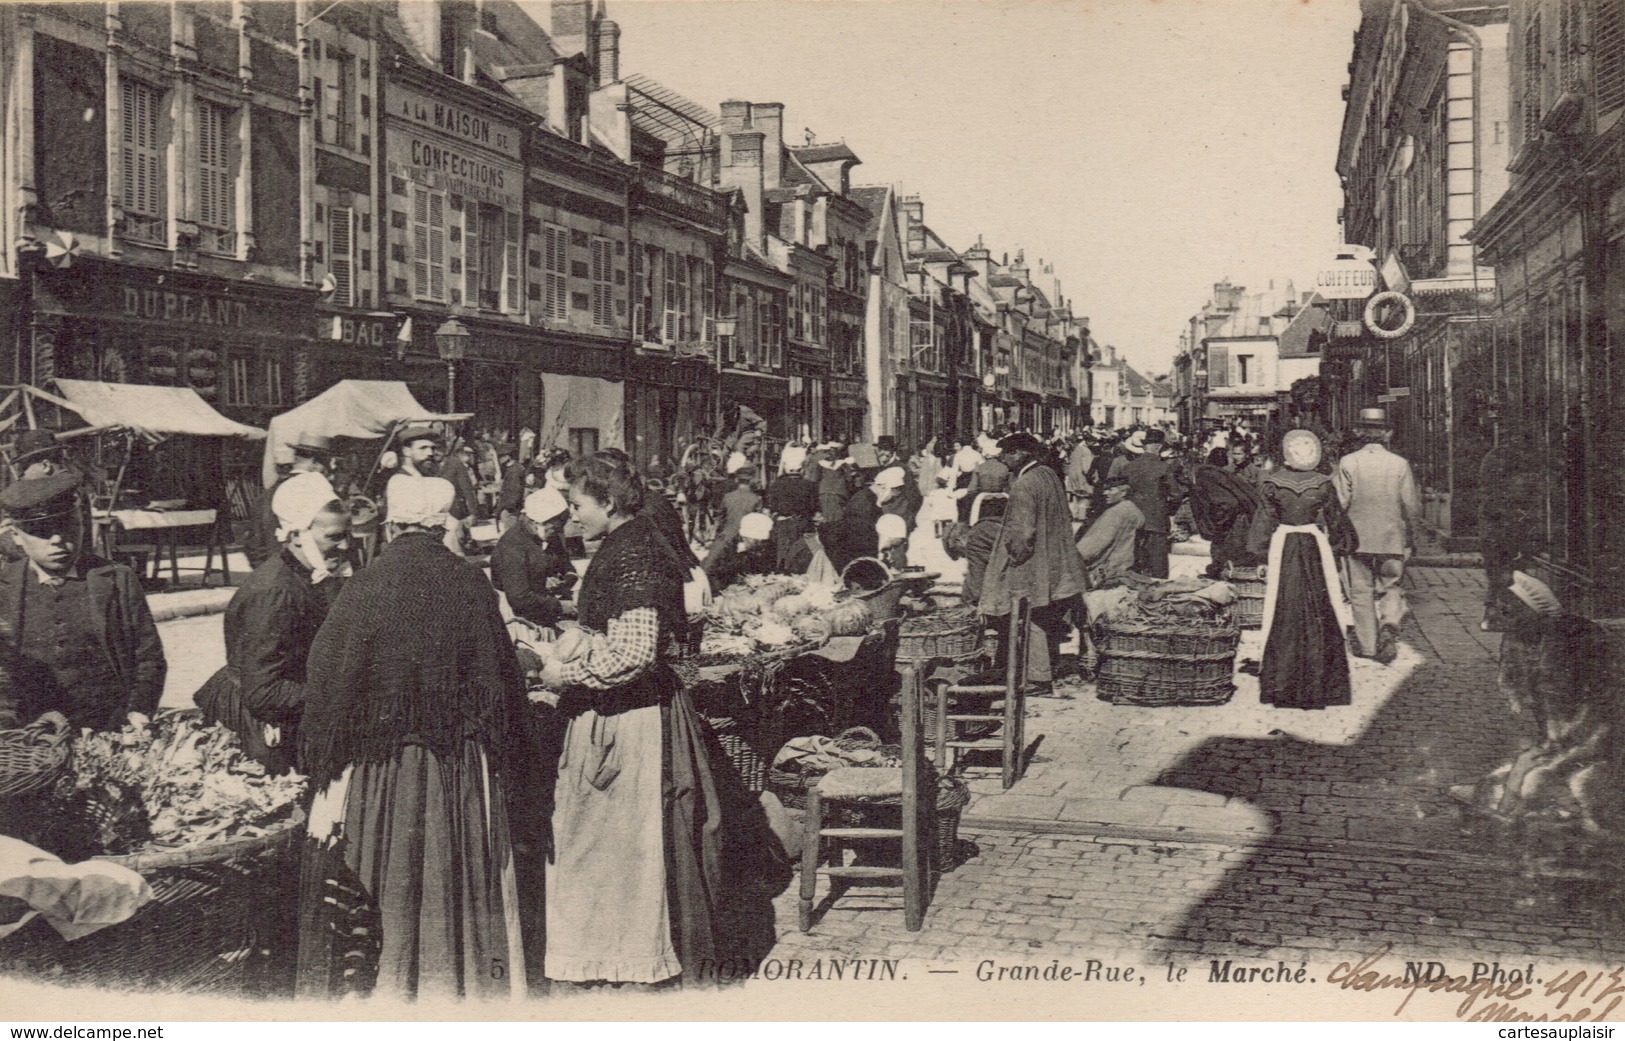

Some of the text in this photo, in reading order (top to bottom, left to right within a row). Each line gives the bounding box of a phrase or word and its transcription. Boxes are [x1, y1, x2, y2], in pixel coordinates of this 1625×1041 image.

[402, 100, 508, 150] A LA MAISON DE
[411, 138, 505, 190] CONFECTIONS
[1317, 269, 1377, 287] COIFFEUR
[124, 287, 248, 327] DUPLANT
